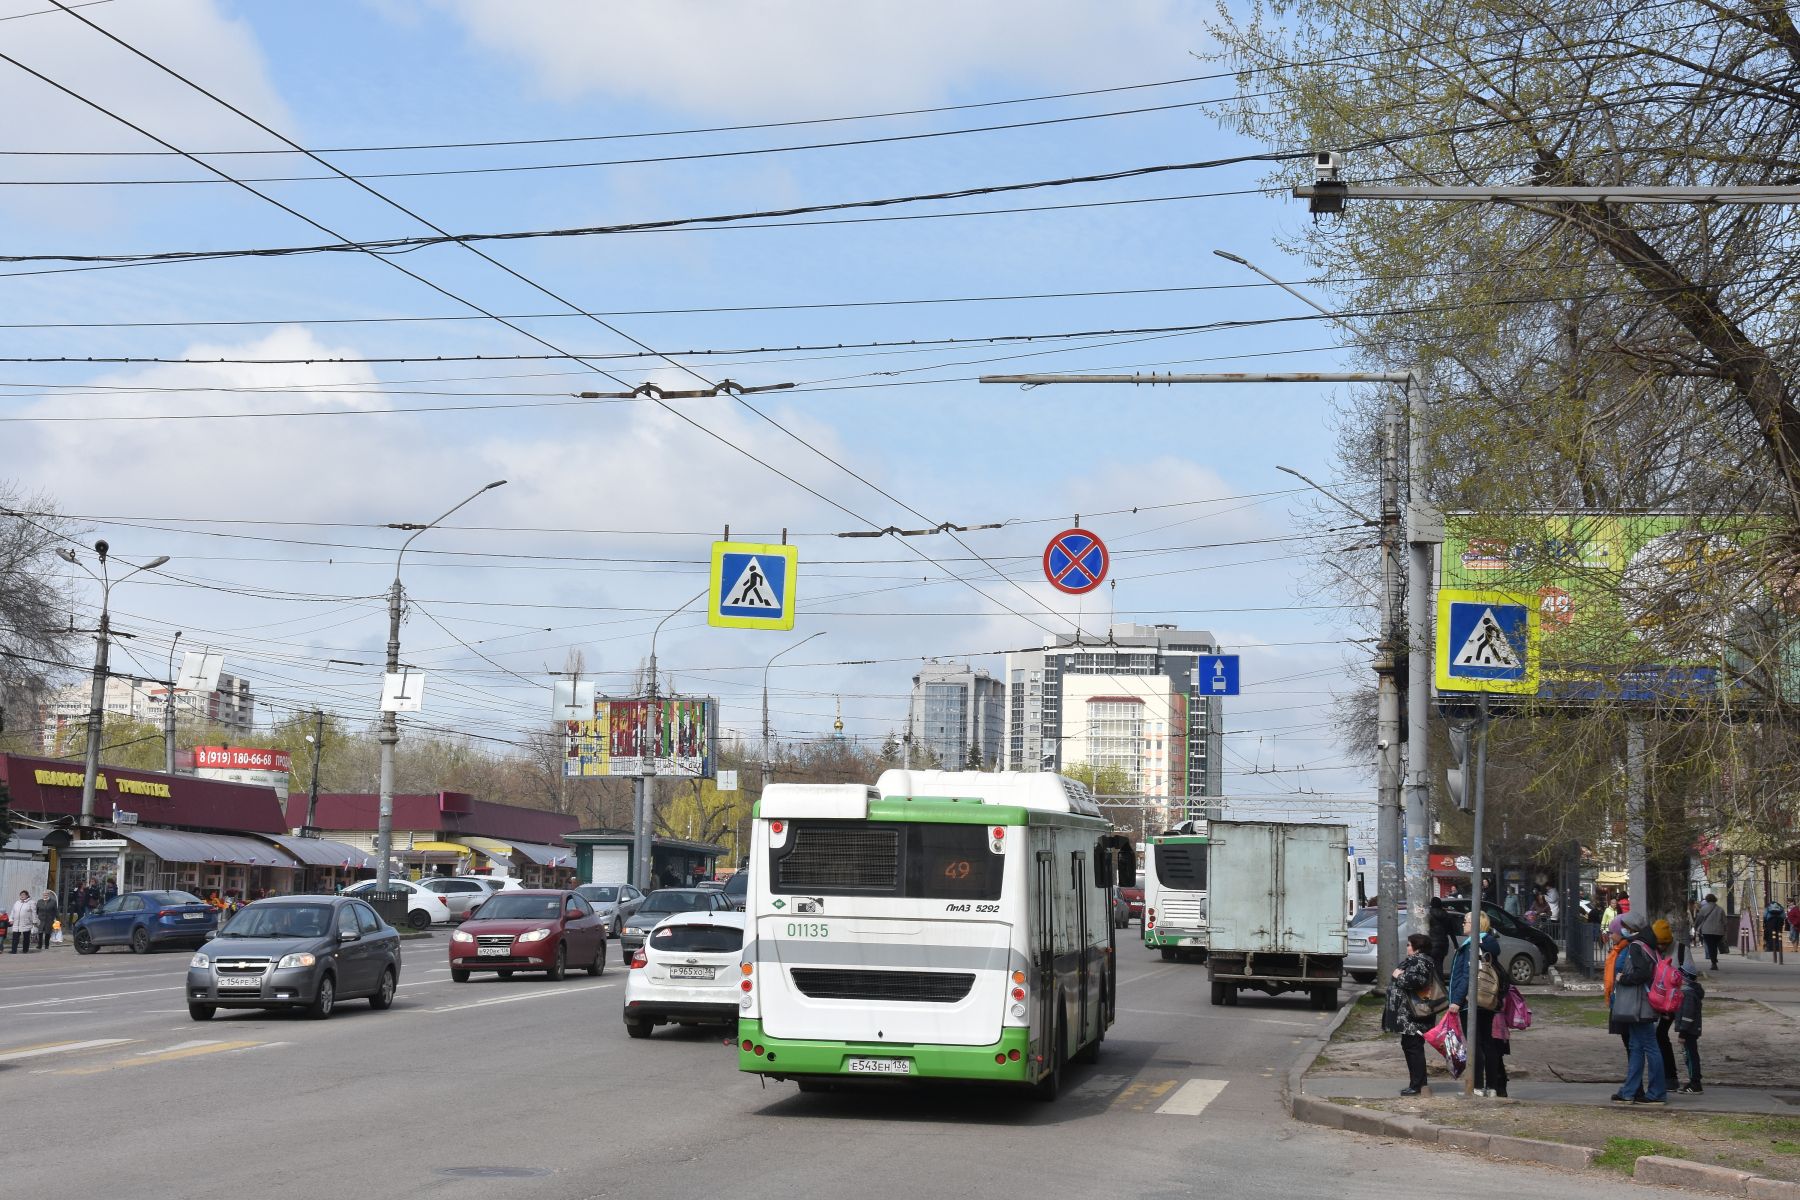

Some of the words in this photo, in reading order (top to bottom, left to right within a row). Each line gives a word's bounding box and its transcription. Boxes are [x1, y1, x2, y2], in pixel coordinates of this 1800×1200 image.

[199, 751, 206, 763] 8
[207, 751, 231, 765] (919)
[233, 752, 272, 766] 180-66-68
[115, 778, 171, 798] ТРИКОТАЖ
[945, 861, 970, 879] 49
[975, 904, 1000, 913] 5292
[787, 923, 829, 938] 01135
[851, 1060, 891, 1072] Е543ЕН
[892, 1060, 908, 1069] 136
